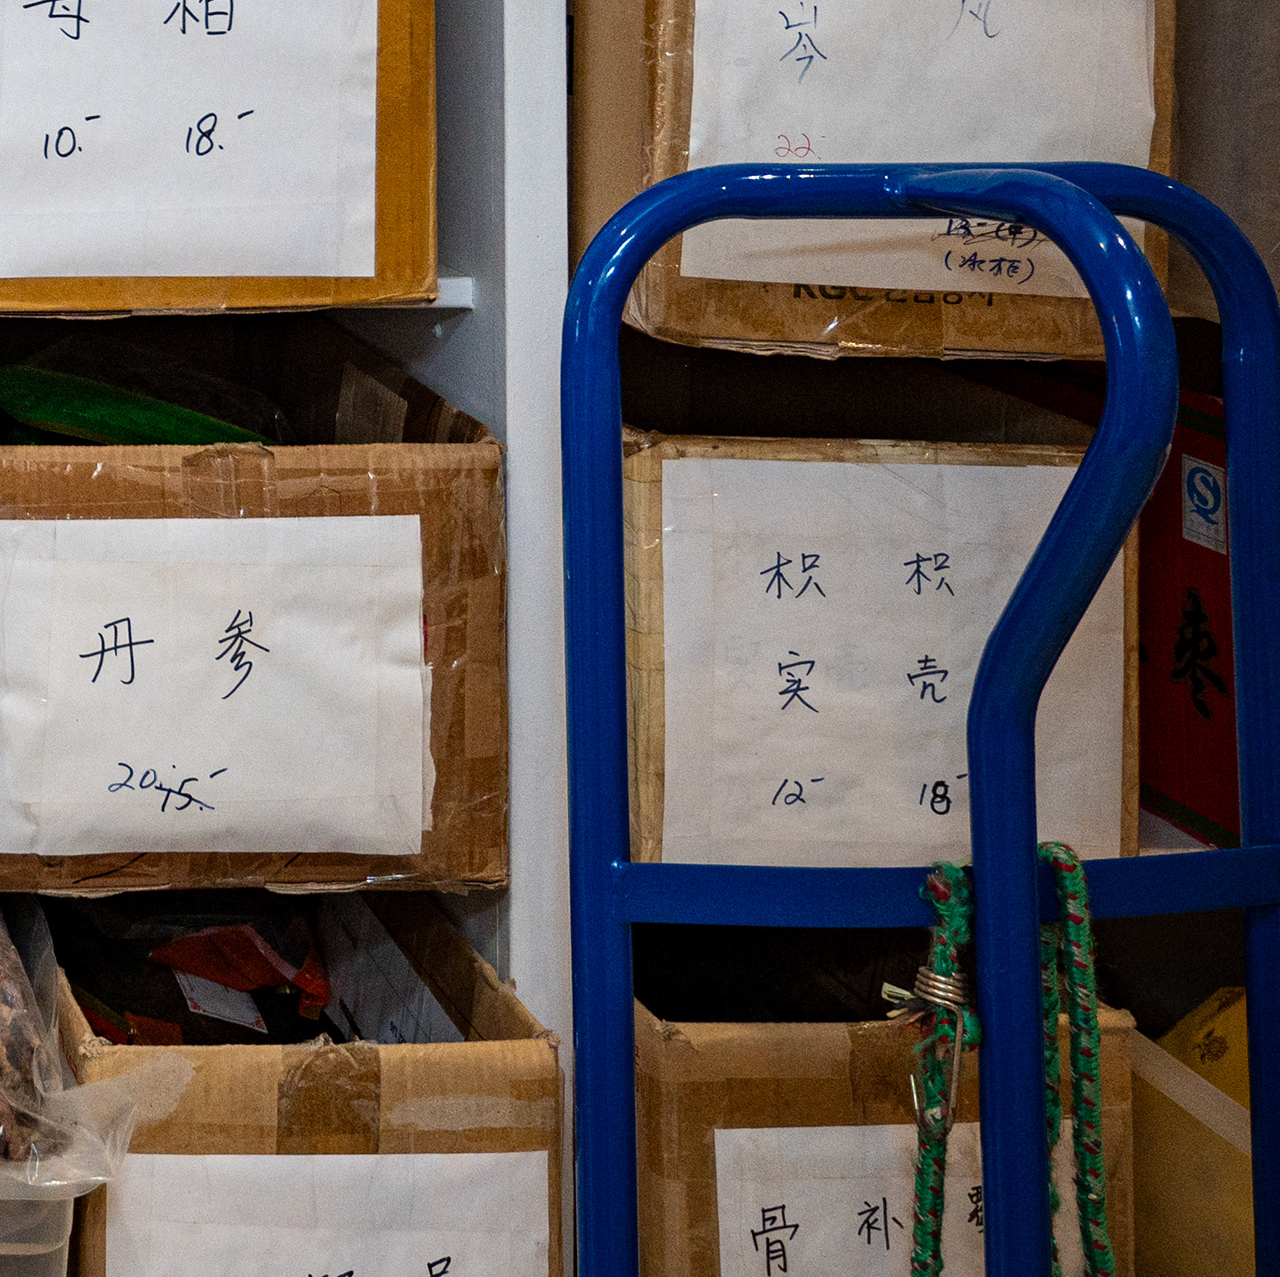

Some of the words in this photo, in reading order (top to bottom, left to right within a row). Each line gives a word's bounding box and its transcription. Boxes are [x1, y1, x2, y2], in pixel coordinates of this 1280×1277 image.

[78, 608, 271, 701] 丹参
[759, 550, 827, 714] 枳实
[903, 551, 955, 705] 枳壳
[857, 1196, 905, 1251] 补
